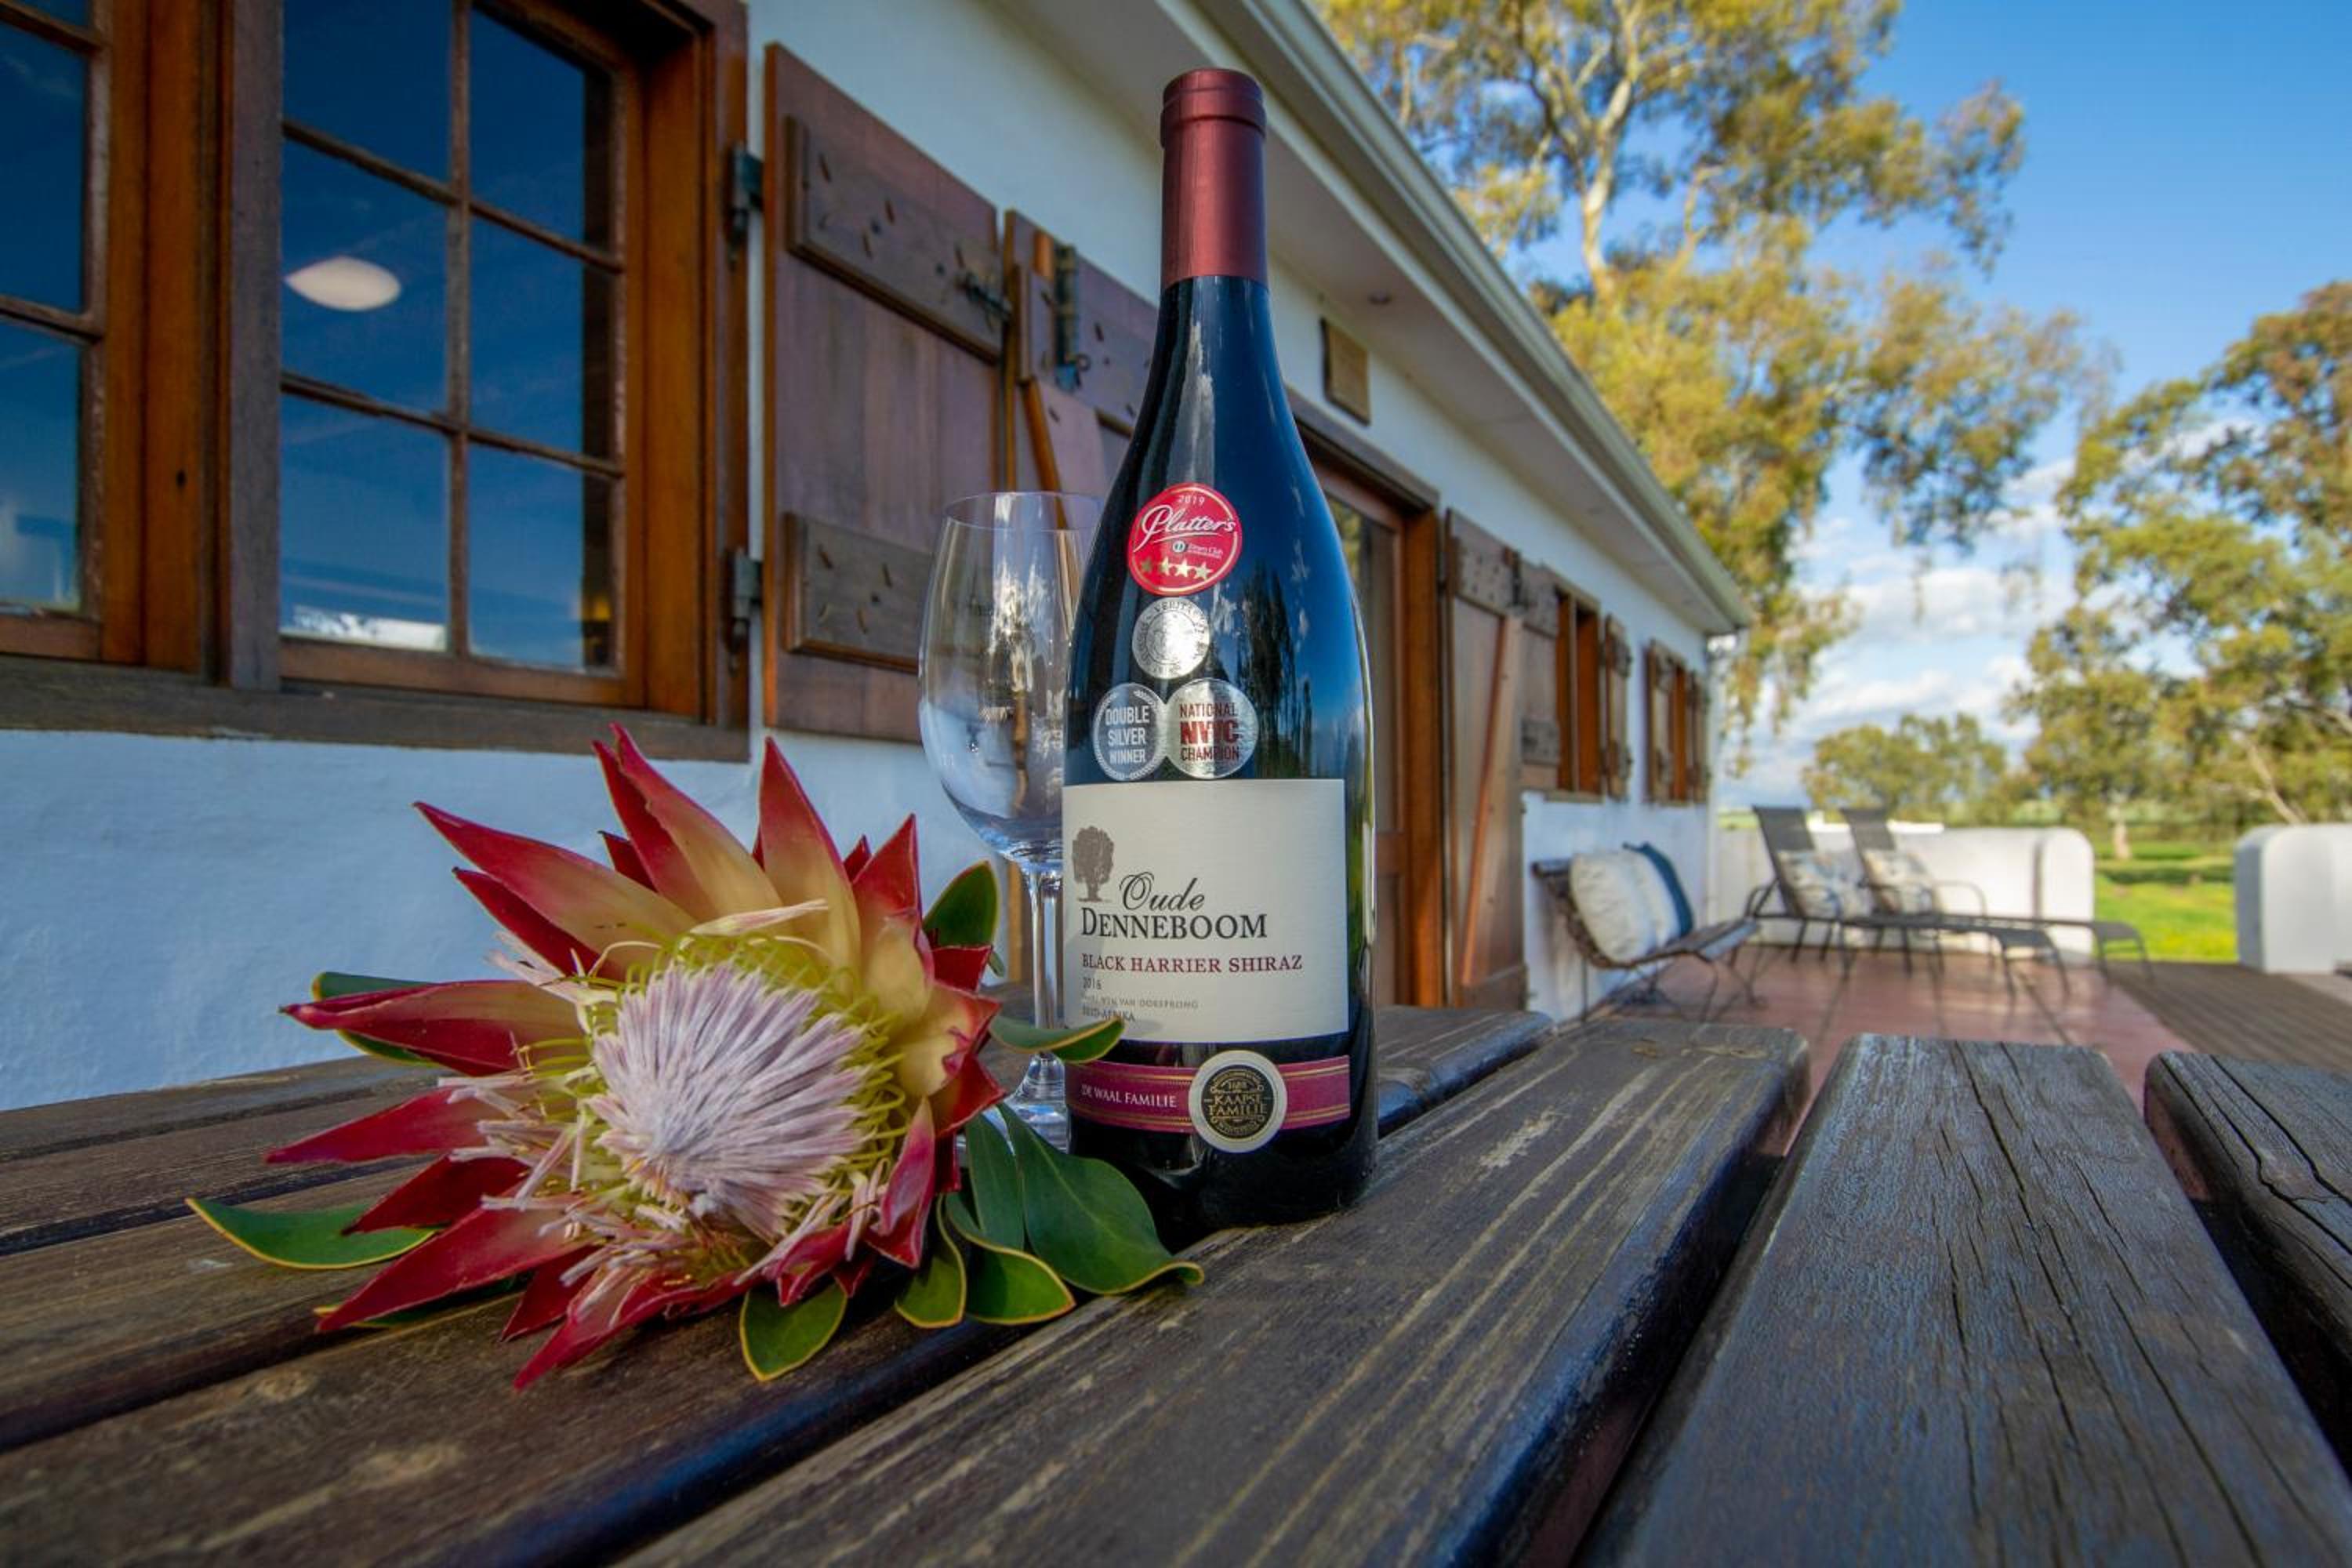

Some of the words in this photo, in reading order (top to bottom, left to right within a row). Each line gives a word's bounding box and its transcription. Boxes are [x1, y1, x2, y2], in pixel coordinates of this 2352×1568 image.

[1105, 705, 1150, 726] DOUBLE
[1180, 702, 1237, 717] NATIONAL
[1108, 727, 1146, 746] SILVER
[1109, 749, 1145, 765] WINNER
[1181, 746, 1240, 761] CHAMPION
[1119, 872, 1205, 911] Oude
[1081, 907, 1268, 939] DENNEBOOM
[1082, 953, 1124, 972] BLACK
[1131, 957, 1222, 973] HARRIER
[1229, 954, 1303, 973] SHIRAZ
[1094, 1087, 1122, 1103] WAAL
[1125, 1092, 1178, 1108] FAMILIE
[1208, 1102, 1267, 1116] FAMILIE
